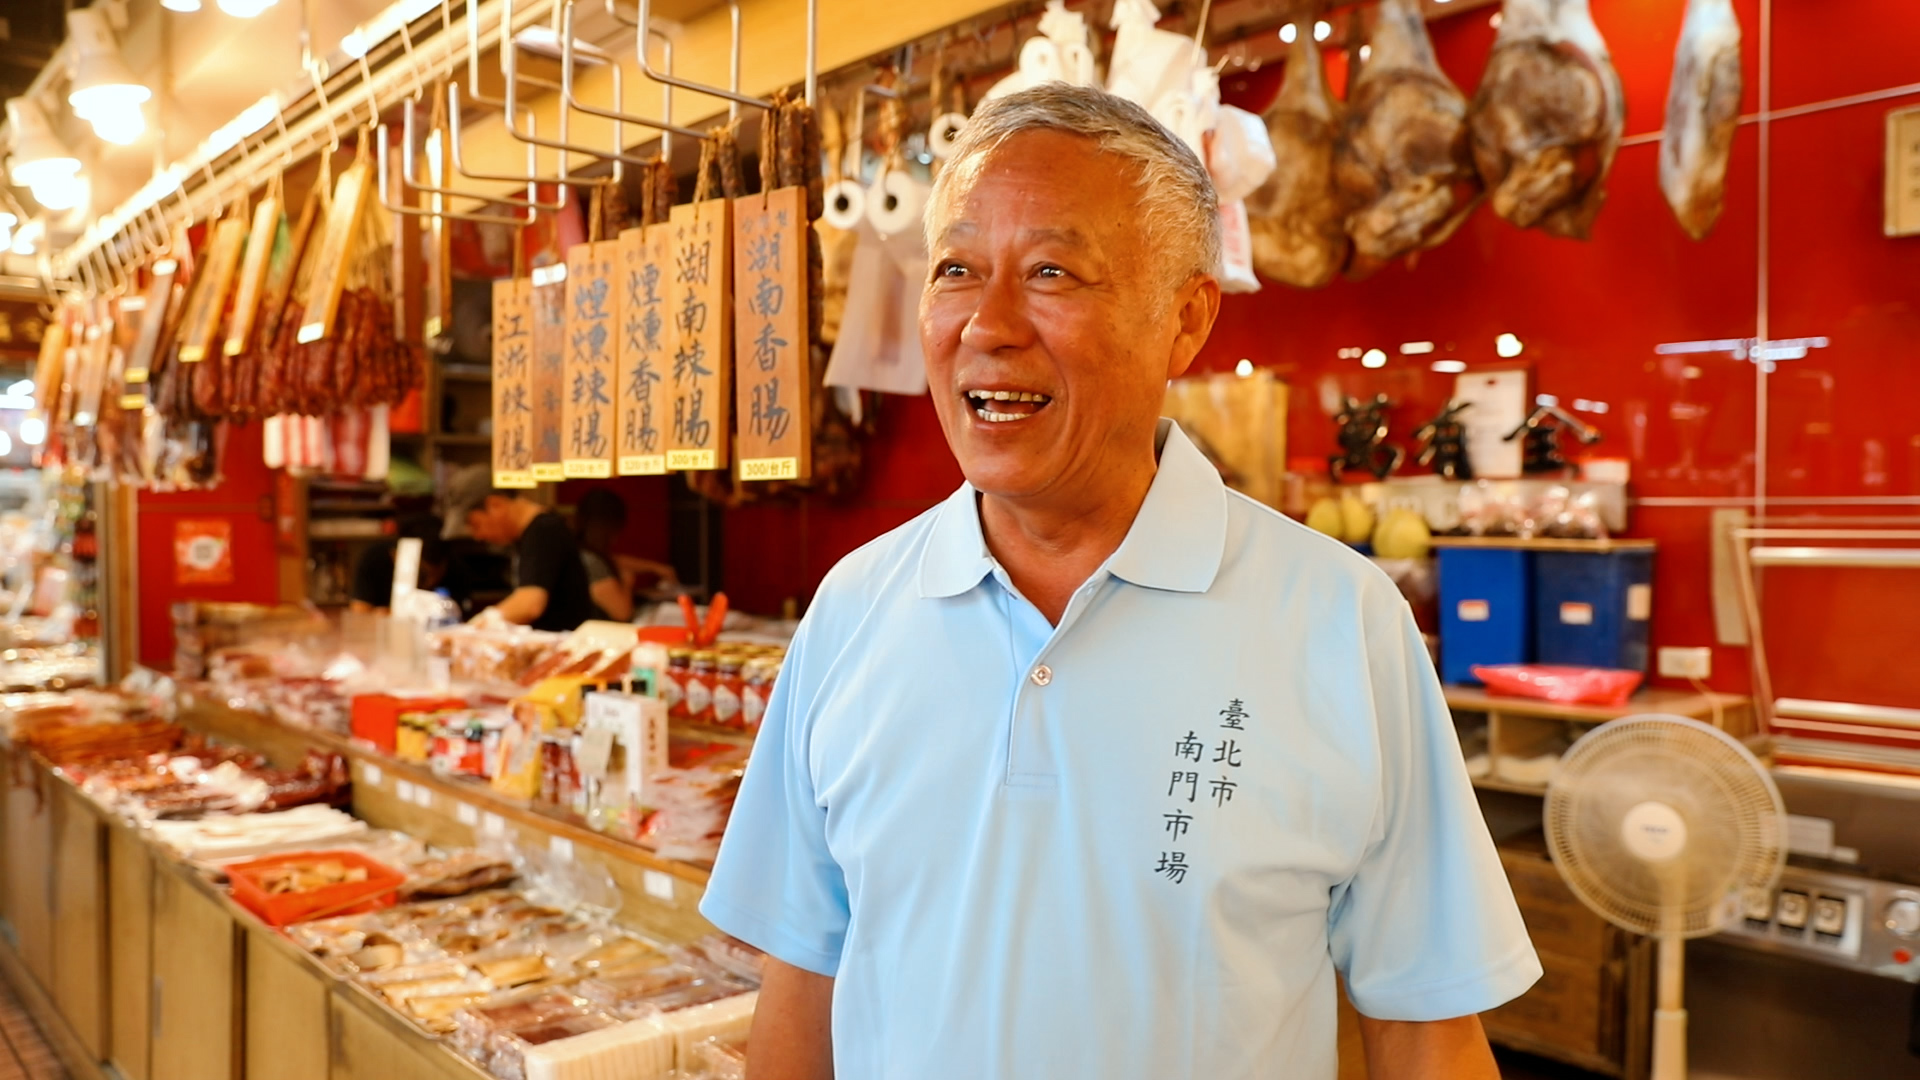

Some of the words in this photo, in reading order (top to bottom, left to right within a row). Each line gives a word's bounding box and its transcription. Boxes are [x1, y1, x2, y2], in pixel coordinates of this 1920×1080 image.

[497, 312, 532, 471] 江浙辣腸
[571, 277, 611, 458] 煙燻辣腸
[625, 263, 663, 454] 煙燻香腸
[672, 240, 713, 449] 湖南辣腸
[746, 232, 791, 445] 湖南香腸
[746, 459, 792, 476] 300/台斤
[1153, 730, 1204, 885] 南門市場
[1209, 697, 1251, 809] 臺北市
